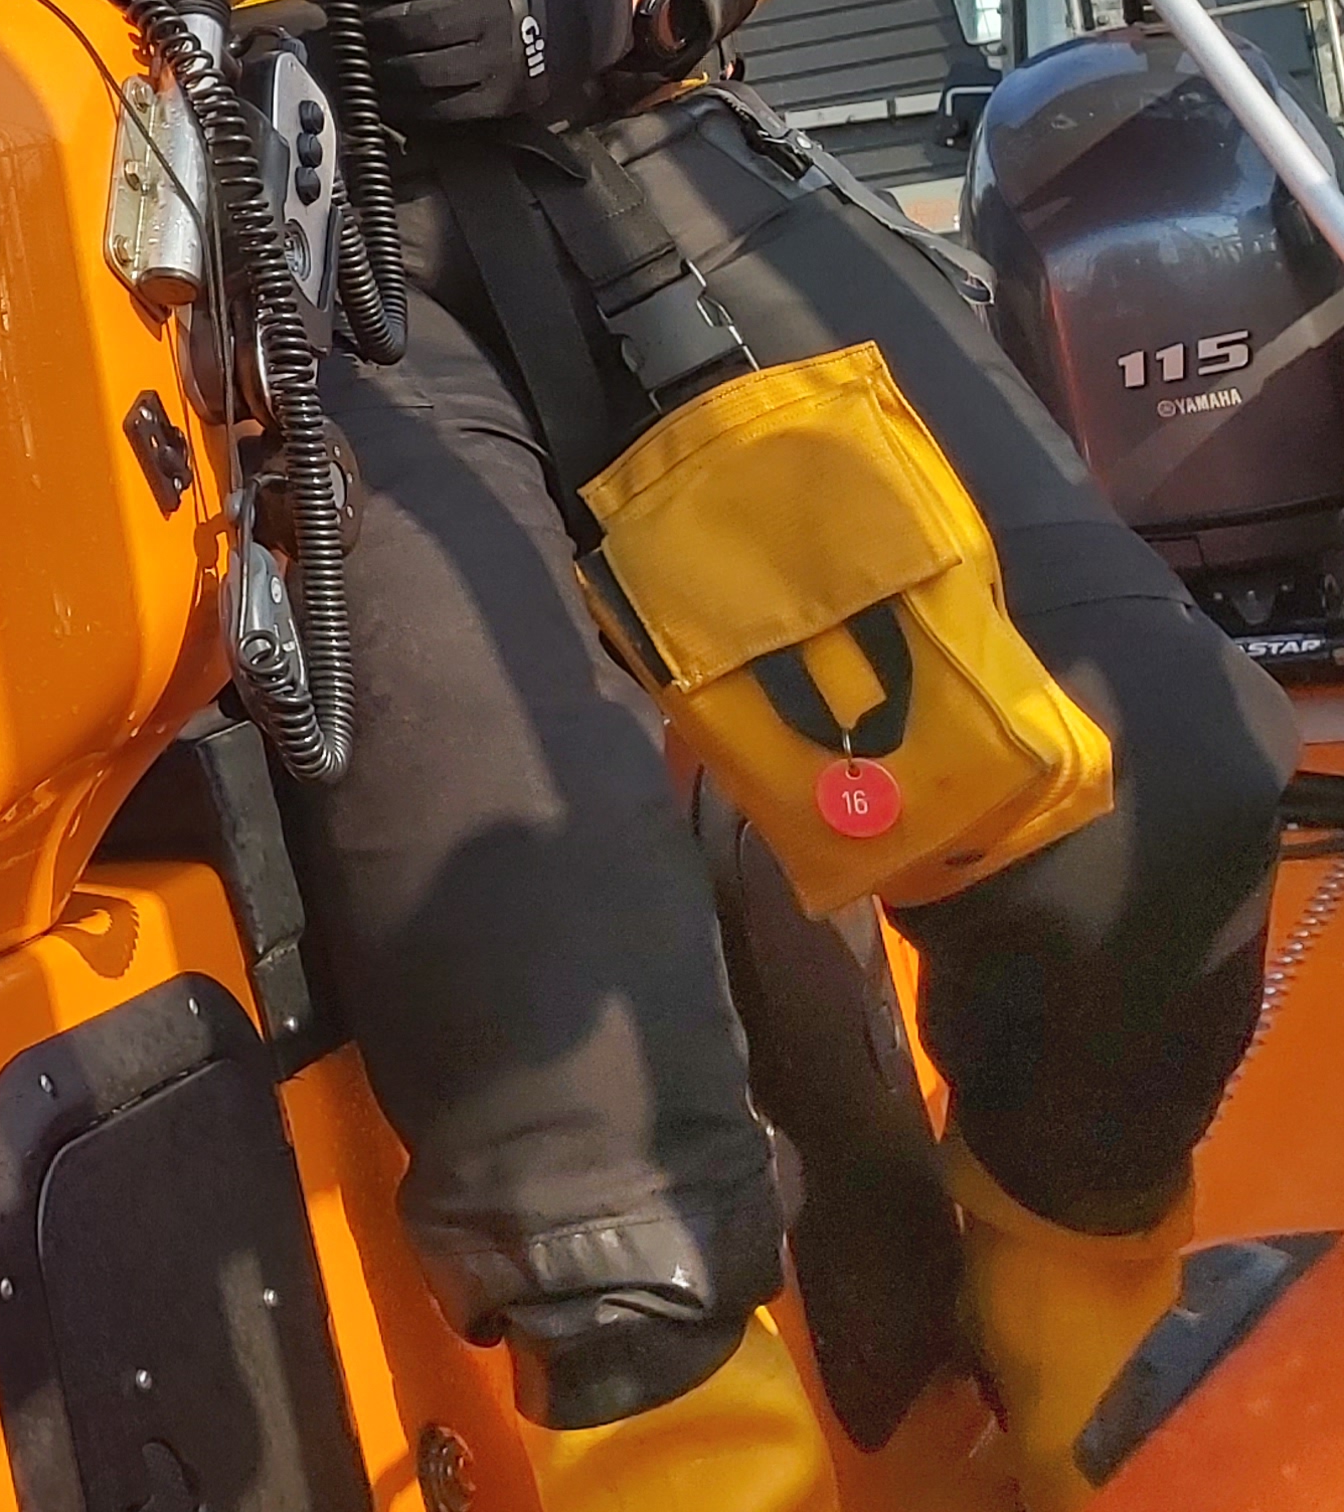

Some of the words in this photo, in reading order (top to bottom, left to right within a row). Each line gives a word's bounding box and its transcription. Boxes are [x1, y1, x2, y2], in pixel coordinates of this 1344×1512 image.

[521, 15, 545, 78] Gill
[1117, 329, 1250, 389] 115
[1173, 387, 1243, 416] YAMAHA
[1238, 639, 1322, 658] STAR
[841, 789, 869, 816] 16
